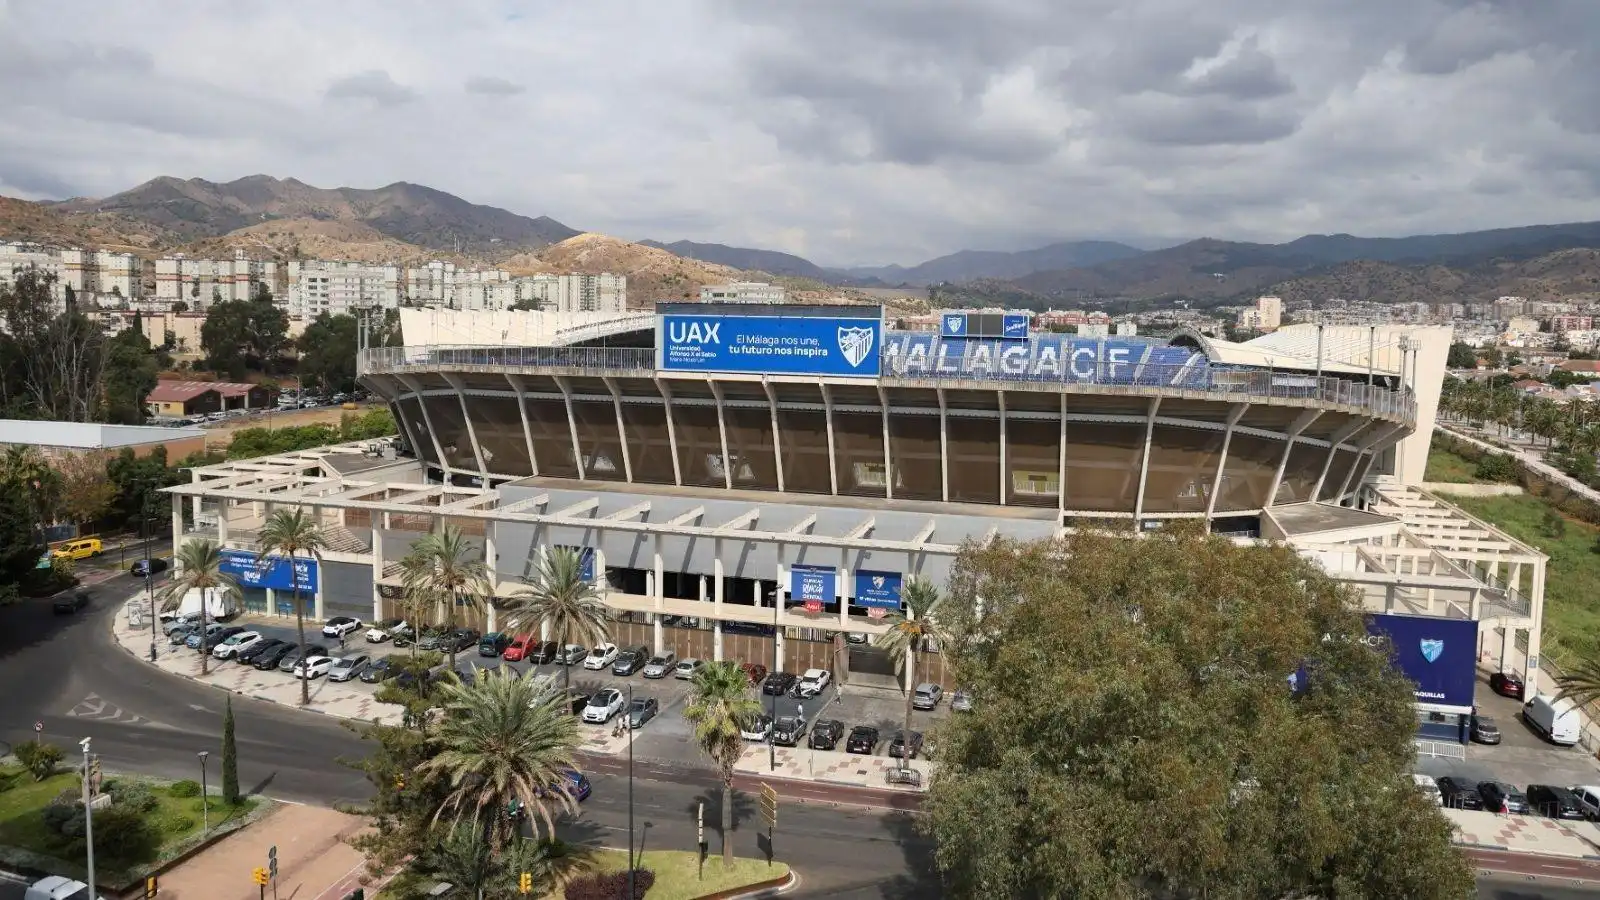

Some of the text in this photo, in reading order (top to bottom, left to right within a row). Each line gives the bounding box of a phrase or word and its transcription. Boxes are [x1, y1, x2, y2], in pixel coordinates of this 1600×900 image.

[669, 322, 720, 344] UAX
[736, 334, 820, 346] El Málaga nos une,
[728, 345, 828, 358] tu futuro nos inspira
